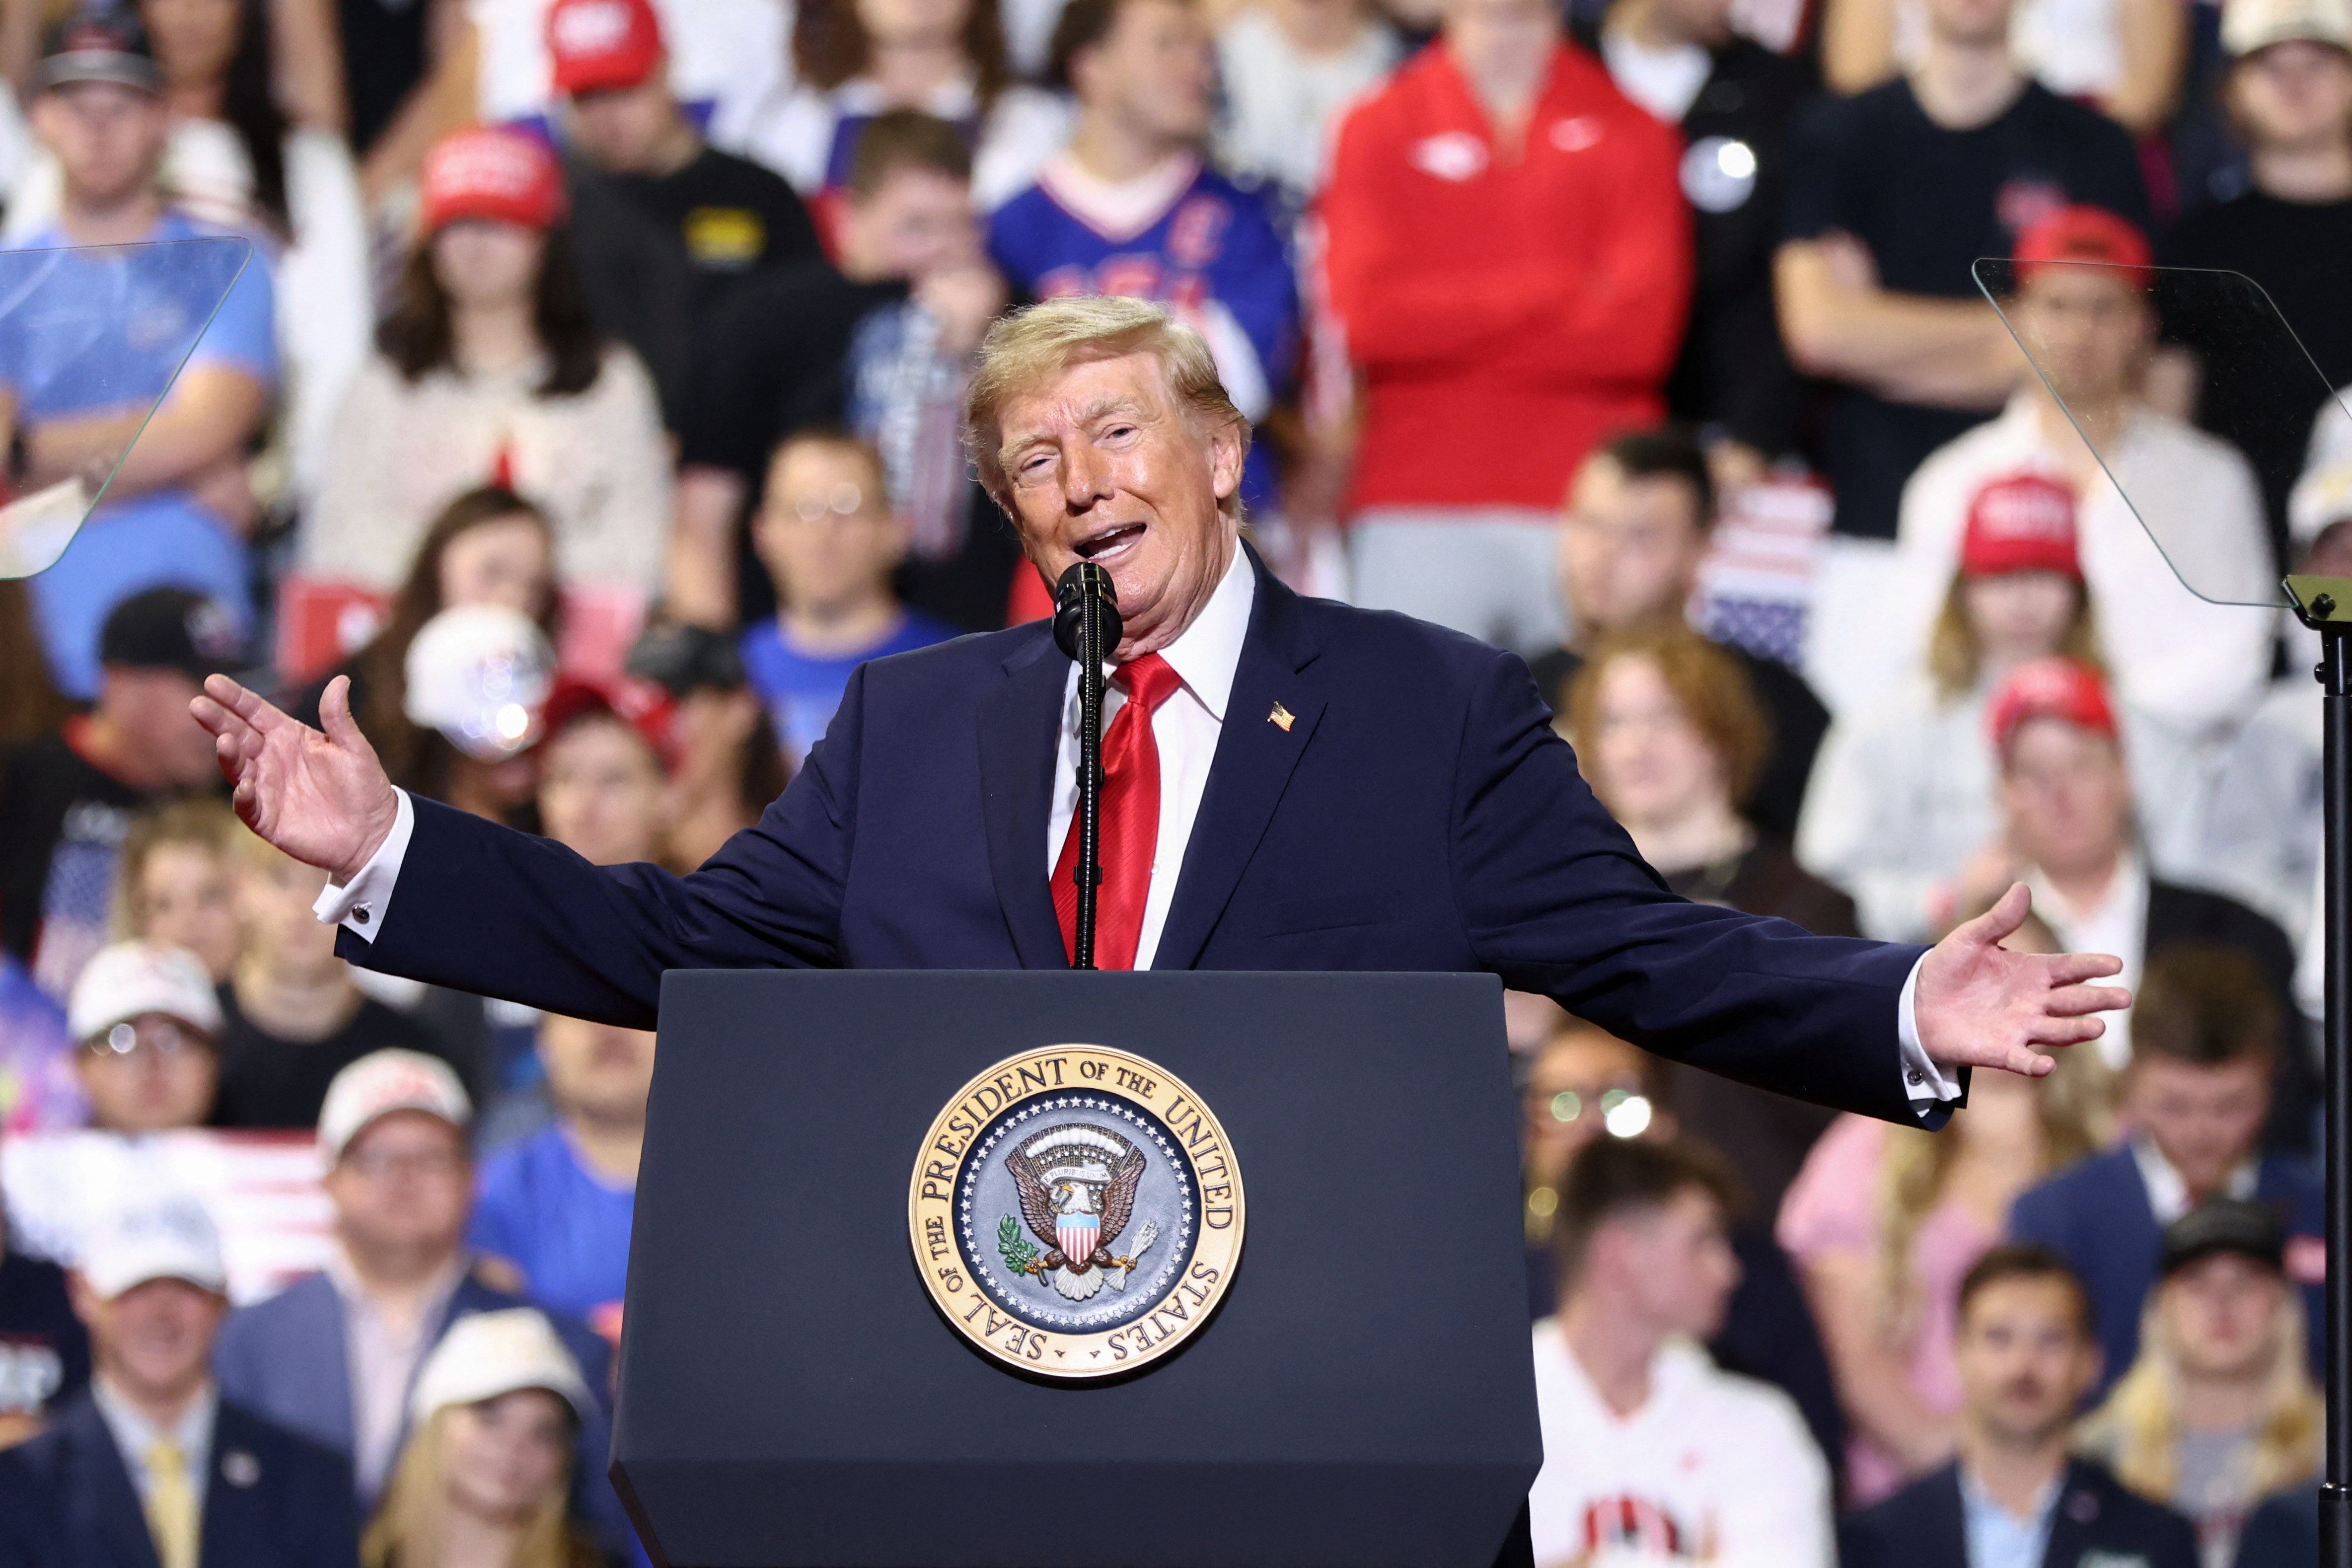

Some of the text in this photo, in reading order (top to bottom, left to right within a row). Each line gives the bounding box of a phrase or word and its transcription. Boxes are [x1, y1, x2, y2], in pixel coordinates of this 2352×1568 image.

[921, 1057, 1233, 1360] SEAL OF THE PRESIDENT OF THE UNITED STATES
[1049, 1169, 1086, 1179] PLURIBUS
